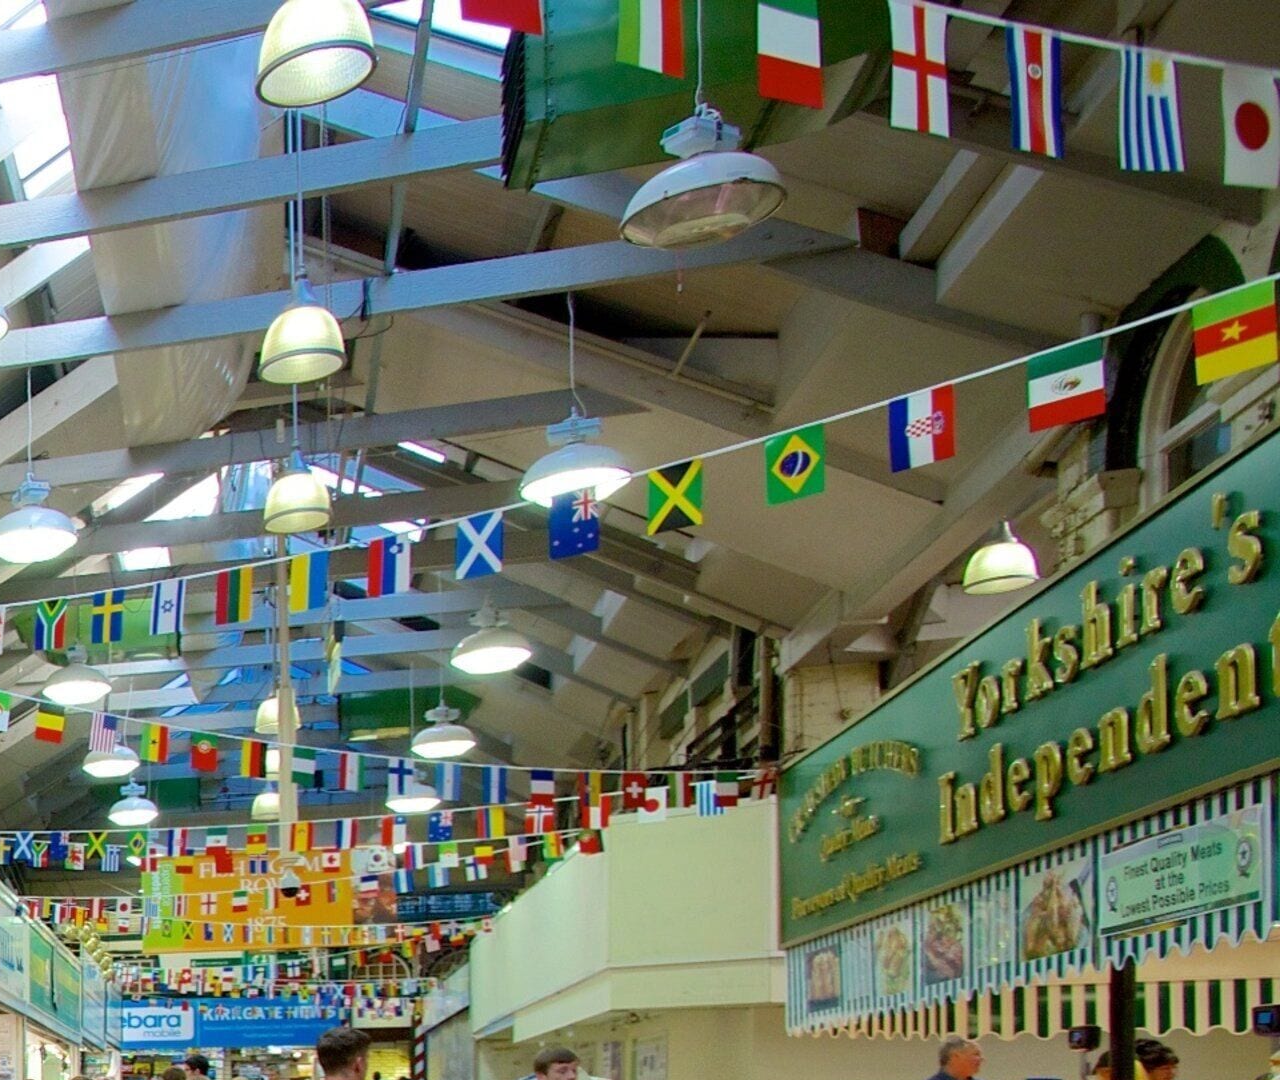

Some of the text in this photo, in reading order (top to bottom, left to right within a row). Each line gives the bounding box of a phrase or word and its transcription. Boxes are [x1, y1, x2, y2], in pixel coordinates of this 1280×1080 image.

[950, 491, 1264, 741] Yorkshire's
[1123, 840, 1223, 882] Finest Quality Meats
[1121, 879, 1231, 918] Lowest Possible Prices
[1153, 872, 1185, 891] at the
[143, 1029, 182, 1038] mobile
